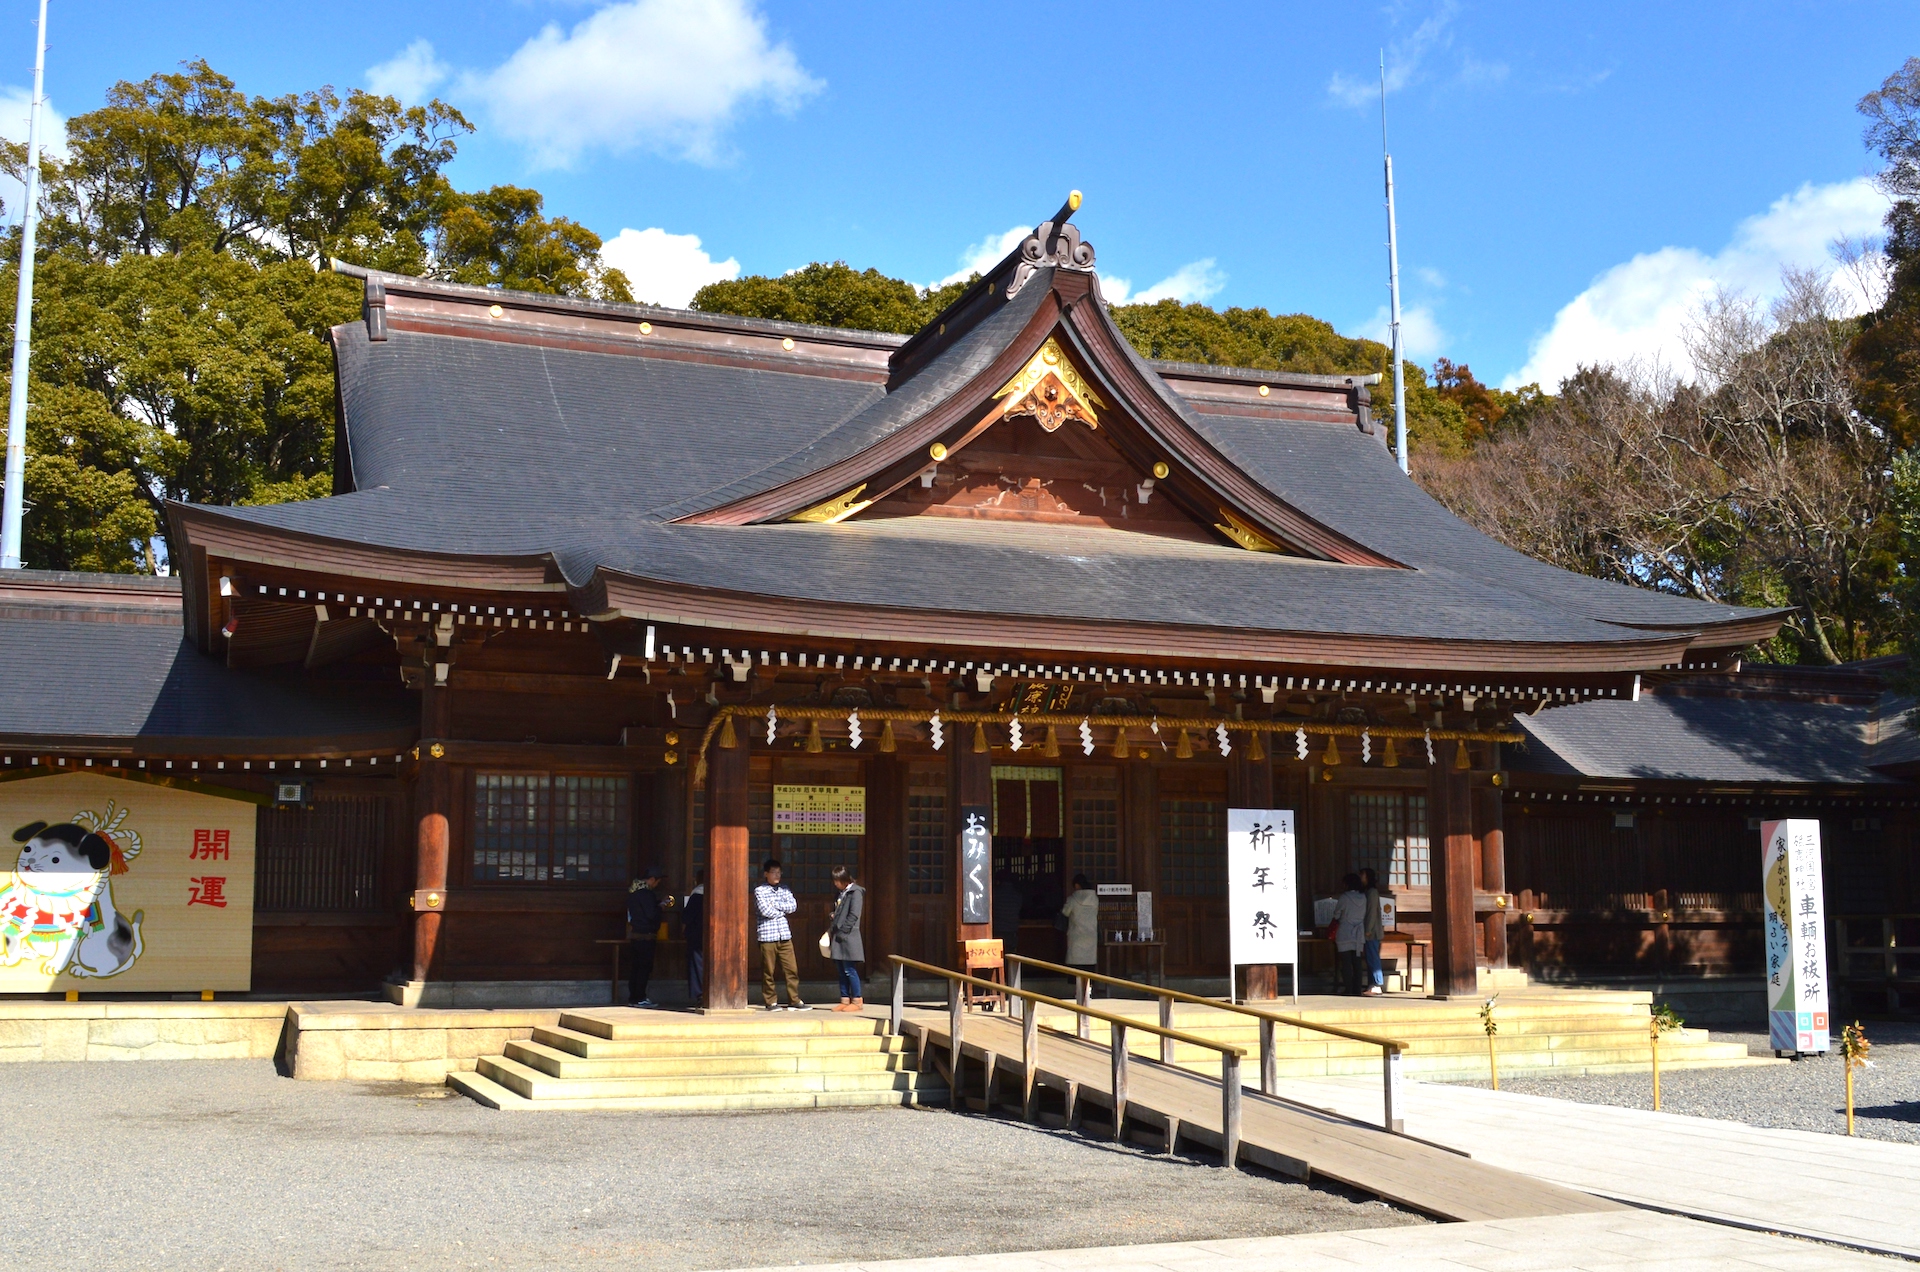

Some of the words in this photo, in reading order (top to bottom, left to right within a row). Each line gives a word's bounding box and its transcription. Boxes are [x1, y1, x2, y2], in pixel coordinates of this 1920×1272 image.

[187, 829, 231, 909] 開運
[965, 812, 986, 917] おみくじ
[1249, 822, 1278, 940] 祈年祭
[969, 948, 998, 957] おみくじ
[1768, 911, 1781, 987] 明るい家庭
